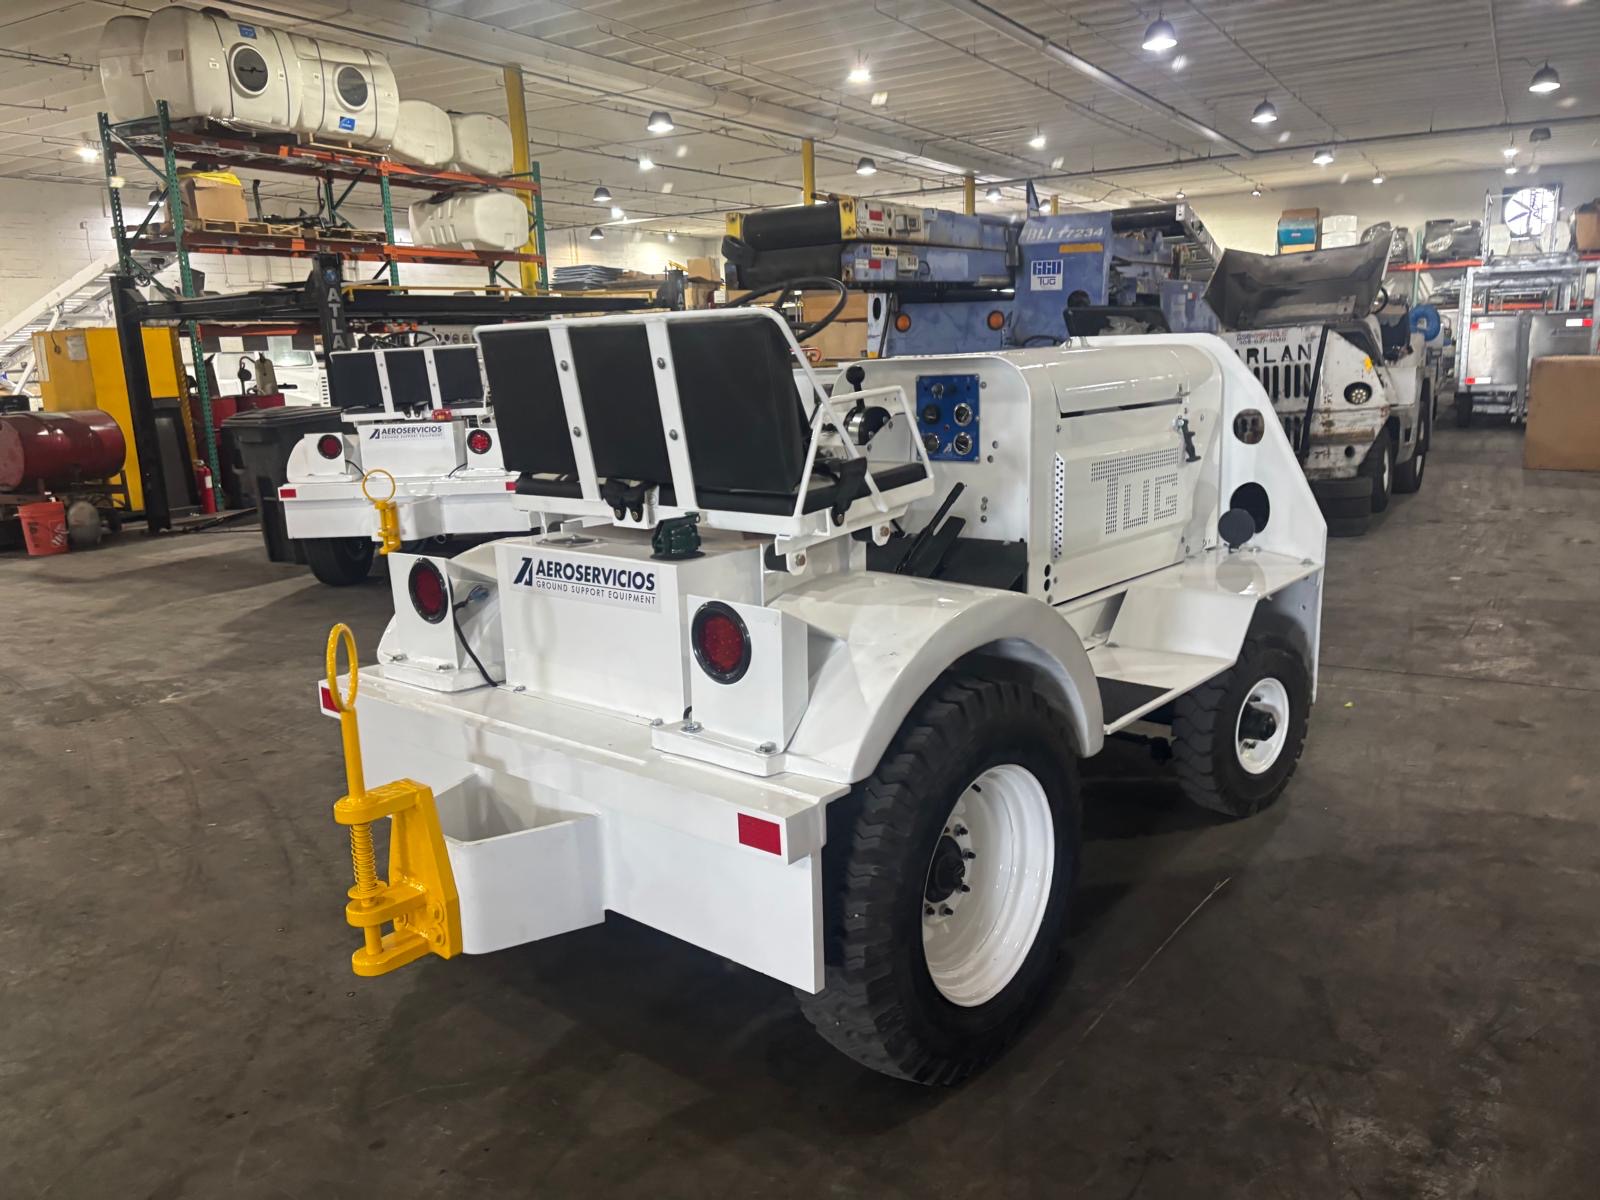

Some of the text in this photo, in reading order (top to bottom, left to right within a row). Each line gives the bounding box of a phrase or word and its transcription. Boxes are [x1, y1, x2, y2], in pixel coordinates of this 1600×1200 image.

[1037, 276, 1057, 286] TUG
[381, 426, 442, 434] AEROSERVICIOS
[1091, 448, 1178, 534] TUG
[536, 559, 656, 591] AEROSERVICIOS
[536, 580, 656, 605] GROUND SUPPORT EQUIPMENT
